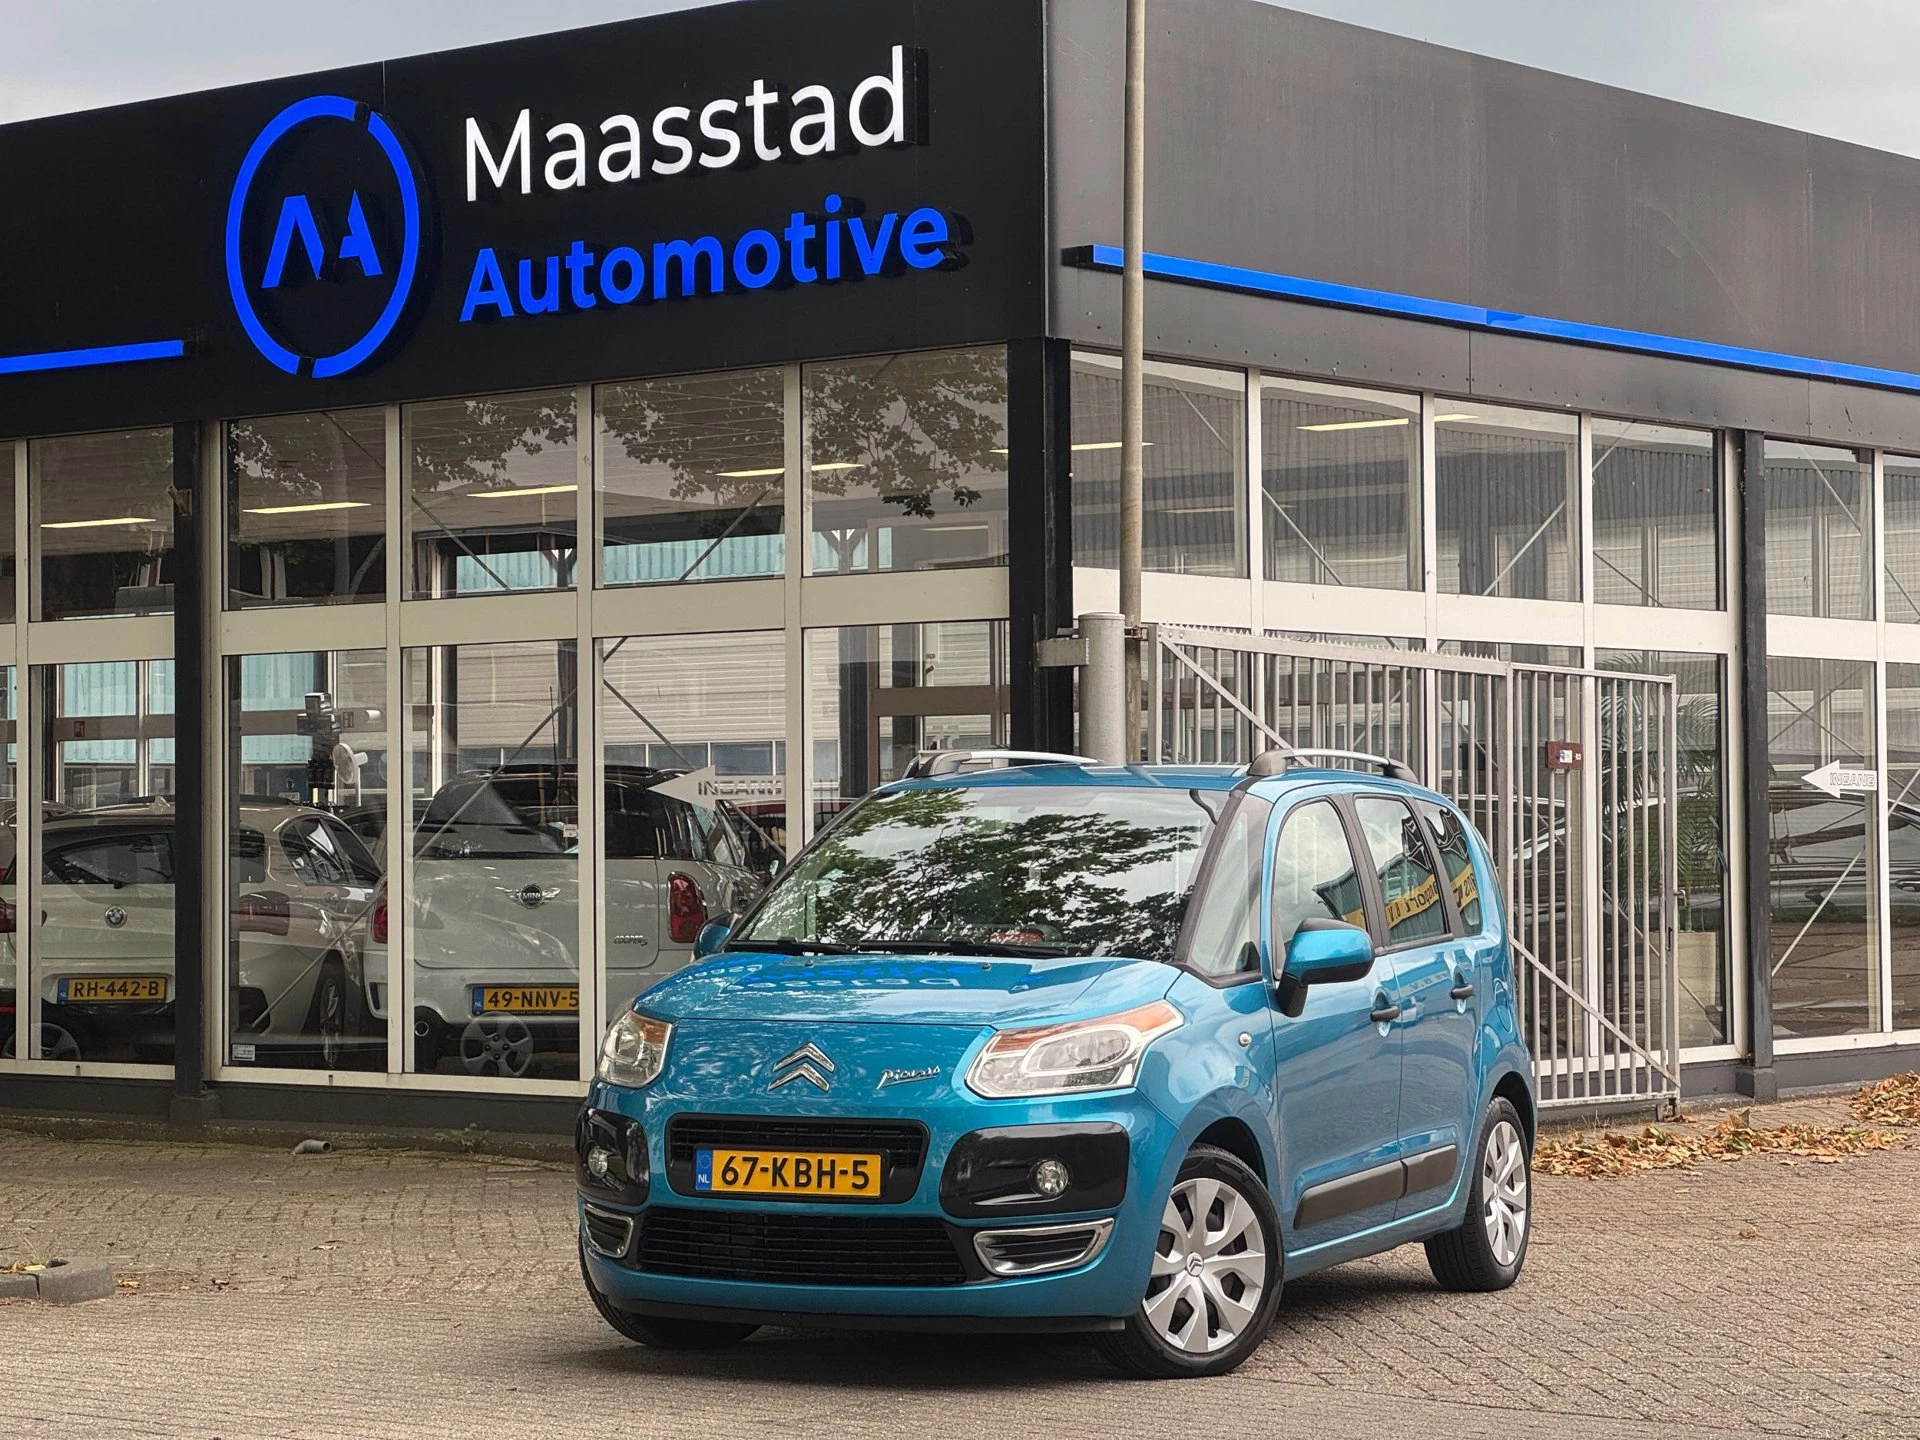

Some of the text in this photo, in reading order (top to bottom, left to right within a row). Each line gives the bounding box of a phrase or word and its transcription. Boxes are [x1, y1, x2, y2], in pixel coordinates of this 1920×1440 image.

[465, 44, 904, 202] Maasstad
[459, 193, 949, 322] Automotive
[1829, 772, 1876, 788] INGANG
[522, 892, 541, 900] MINI
[73, 980, 160, 998] RH-442-B
[487, 990, 580, 1008] 49-NNV-5
[698, 1155, 870, 1190] NL 67-KBH-5
